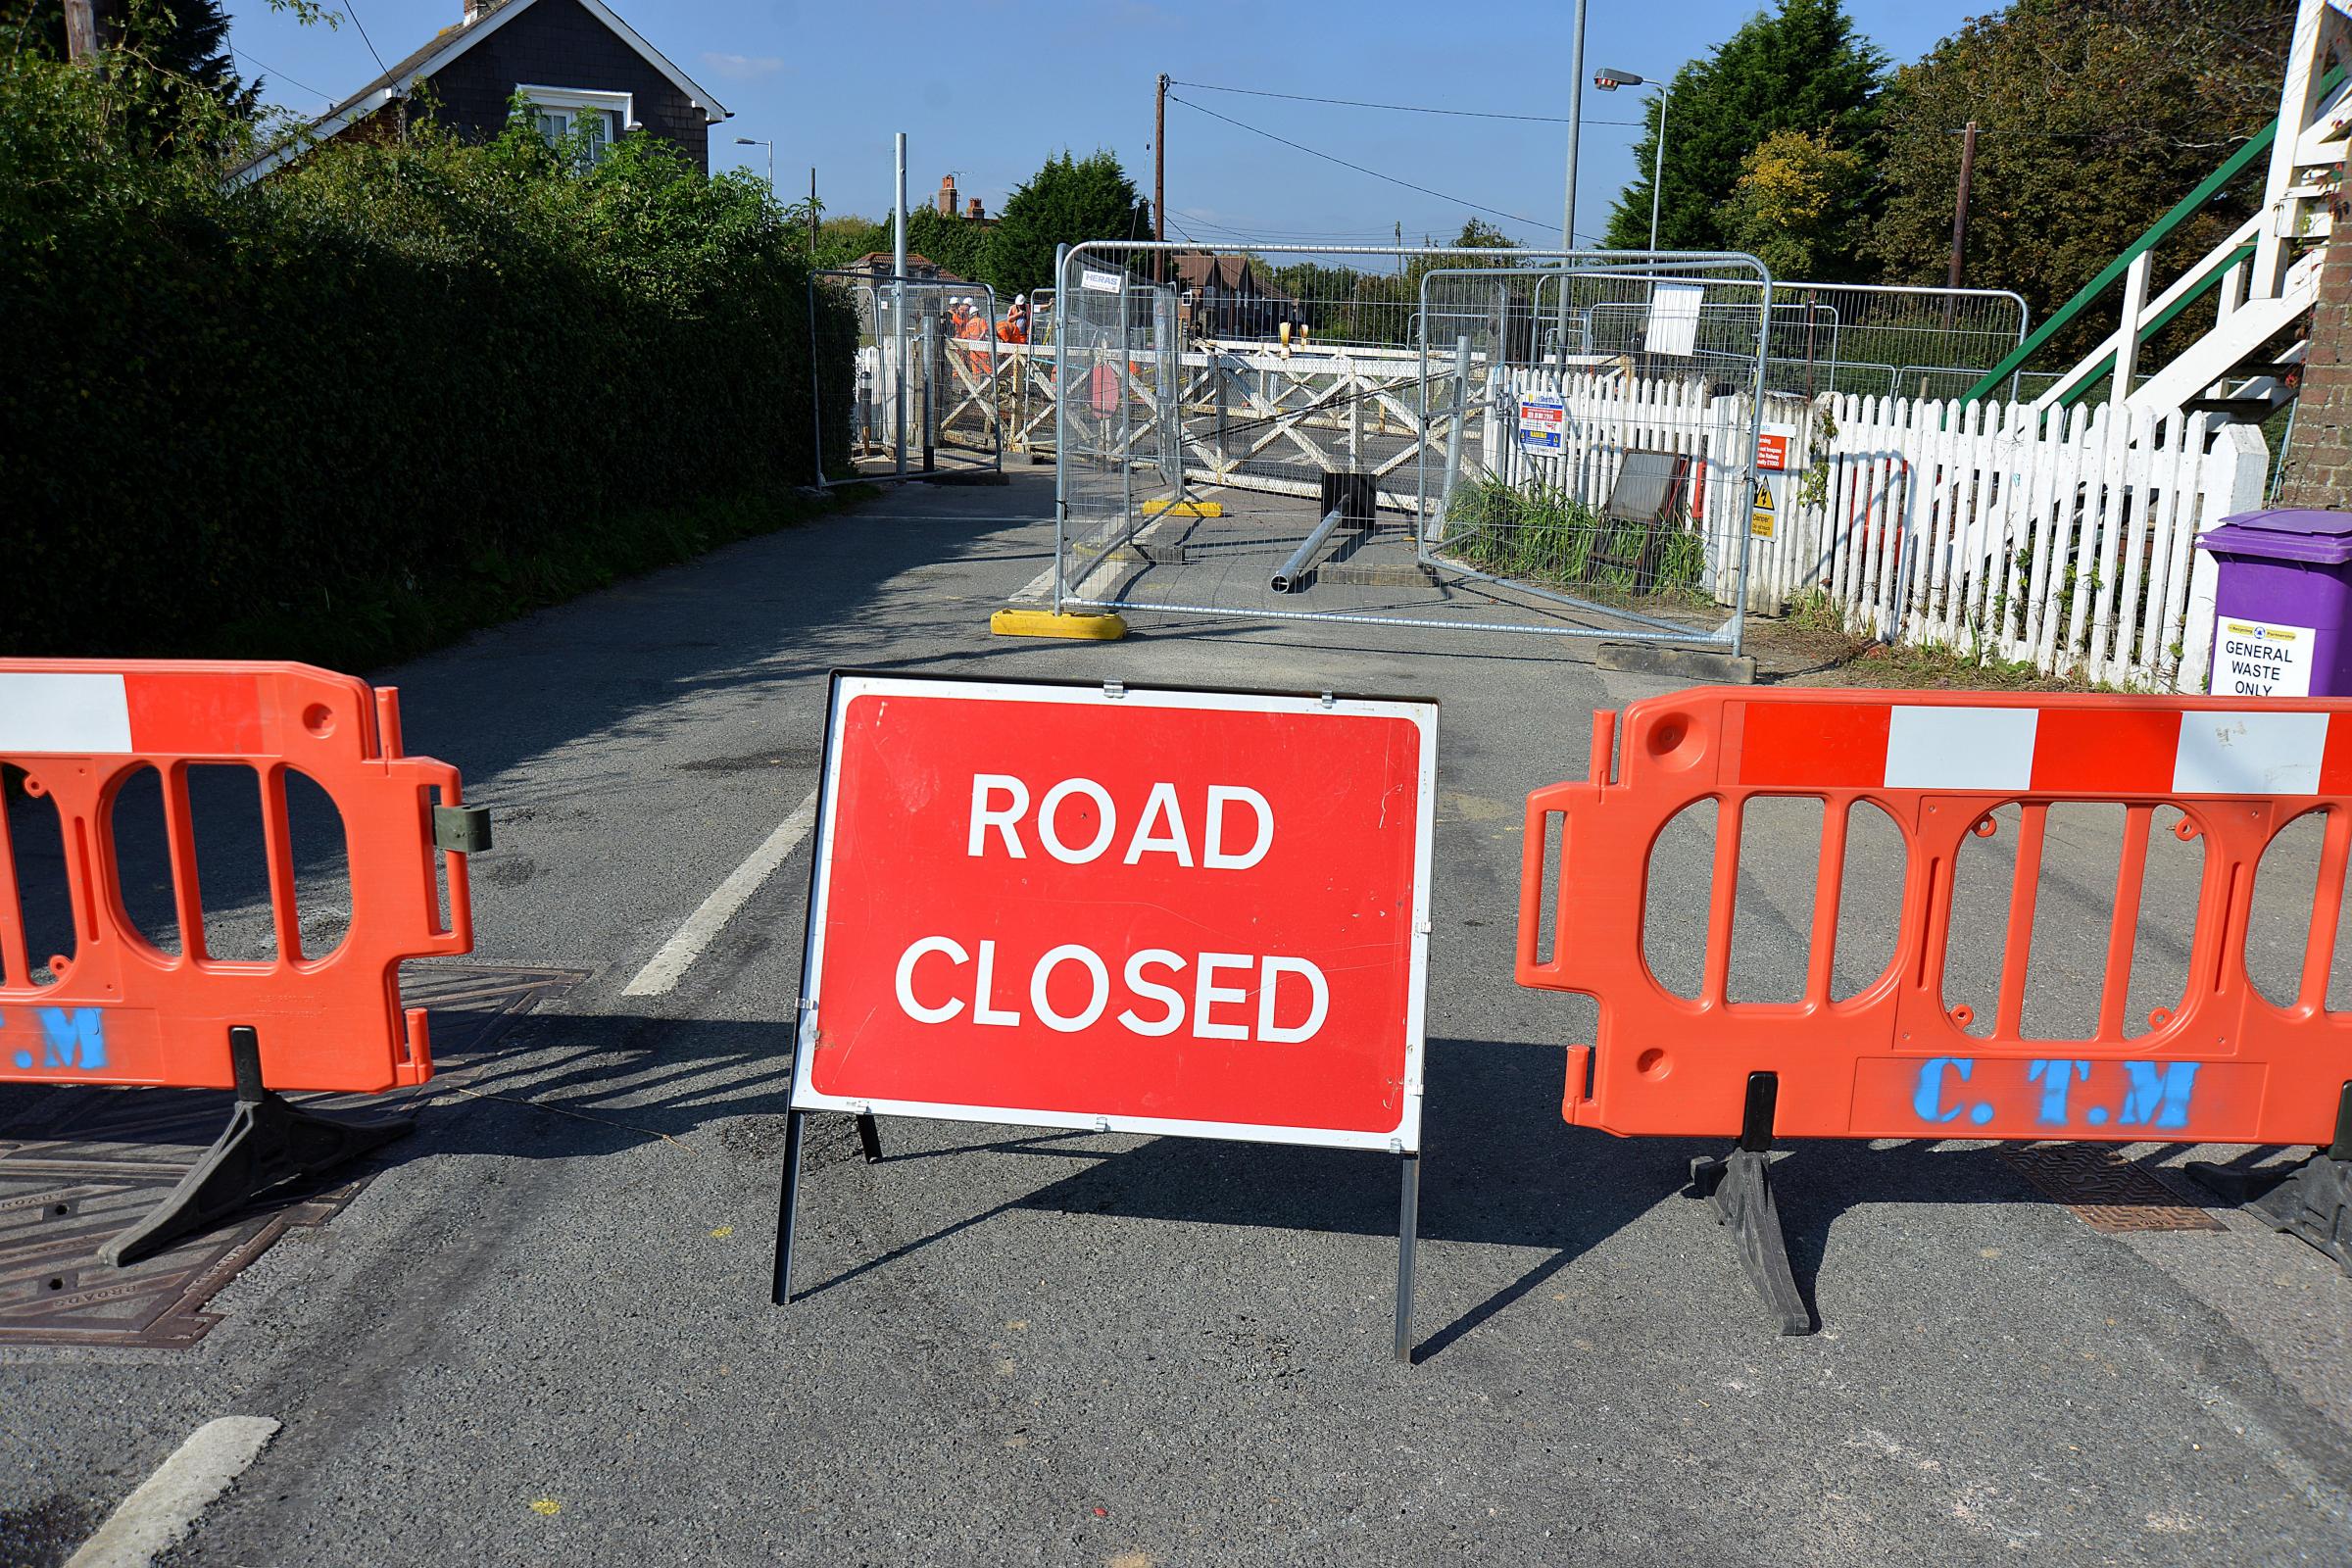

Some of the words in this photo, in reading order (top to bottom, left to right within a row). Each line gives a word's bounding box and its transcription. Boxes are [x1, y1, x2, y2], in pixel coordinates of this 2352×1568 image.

[1086, 273, 1118, 285] HERAS
[1753, 514, 1770, 523] Danger
[2267, 631, 2296, 640] Partnership
[2226, 641, 2292, 663] GENERAL
[2231, 661, 2280, 680] WASTE
[2235, 680, 2272, 697] ONLY
[967, 773, 1274, 870] ROAD
[895, 935, 1330, 1044] CLOSED
[54, 1285, 137, 1307] BROADS
